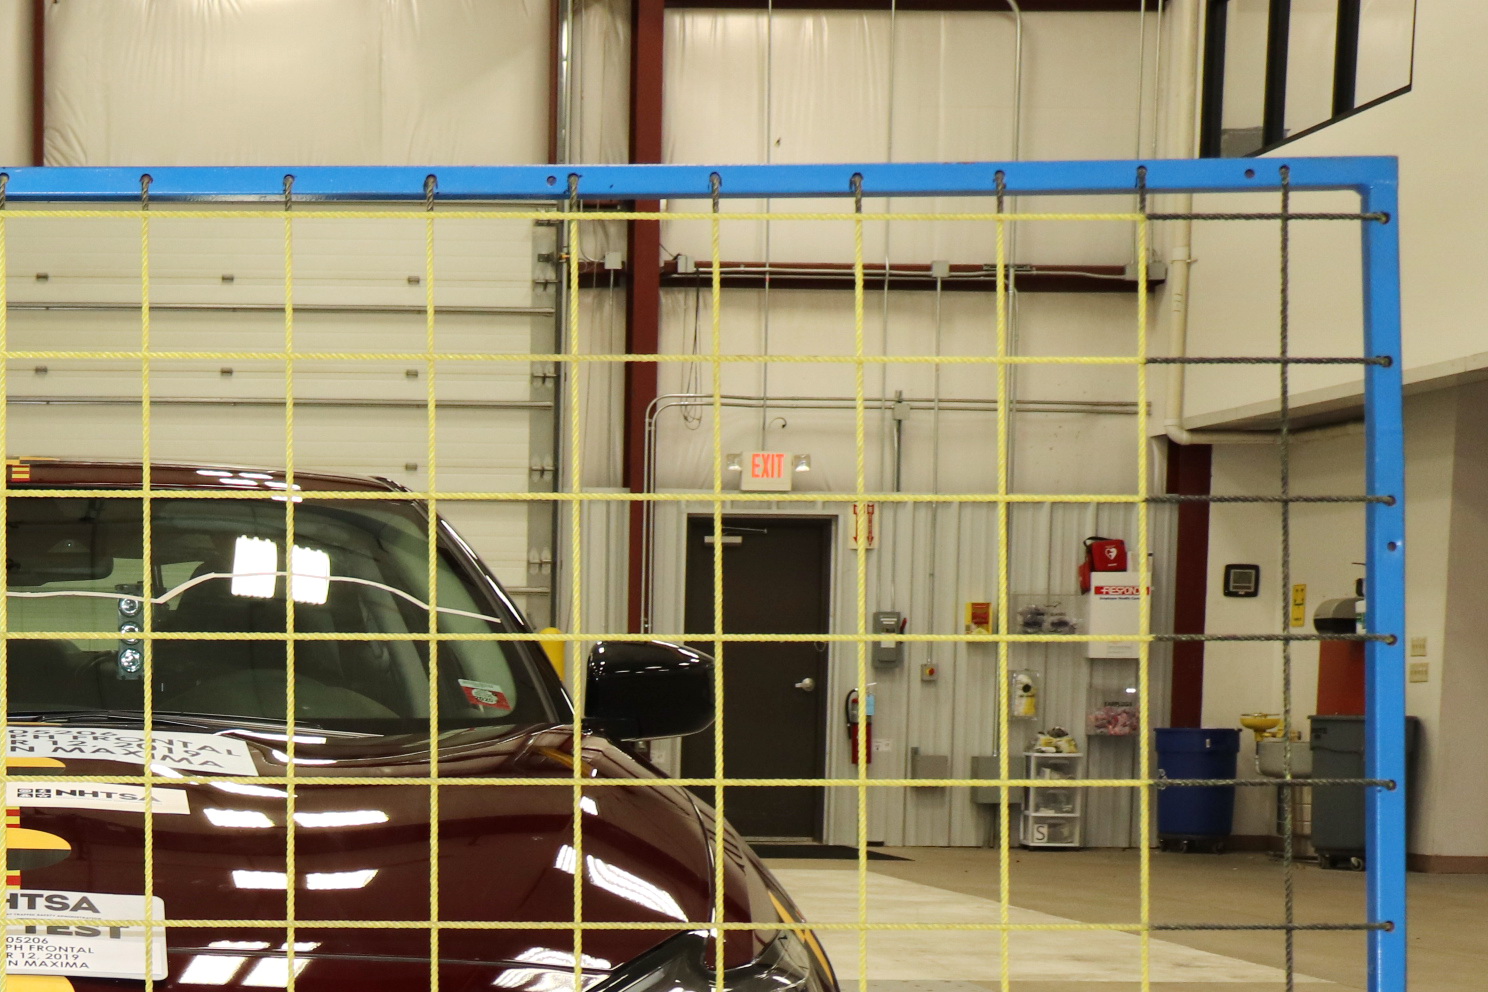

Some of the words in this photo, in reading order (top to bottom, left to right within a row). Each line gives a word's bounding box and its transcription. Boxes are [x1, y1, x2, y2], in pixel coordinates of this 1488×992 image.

[751, 453, 785, 479] EXIT
[73, 734, 241, 757] FRONTAL
[114, 741, 201, 757] 2019
[52, 746, 224, 768] MAXIMA
[55, 789, 162, 803] NHTSA
[1035, 825, 1046, 841] S
[29, 945, 95, 954] FRONTAL
[45, 953, 80, 961] 2019
[23, 960, 90, 969] MAXIMA
